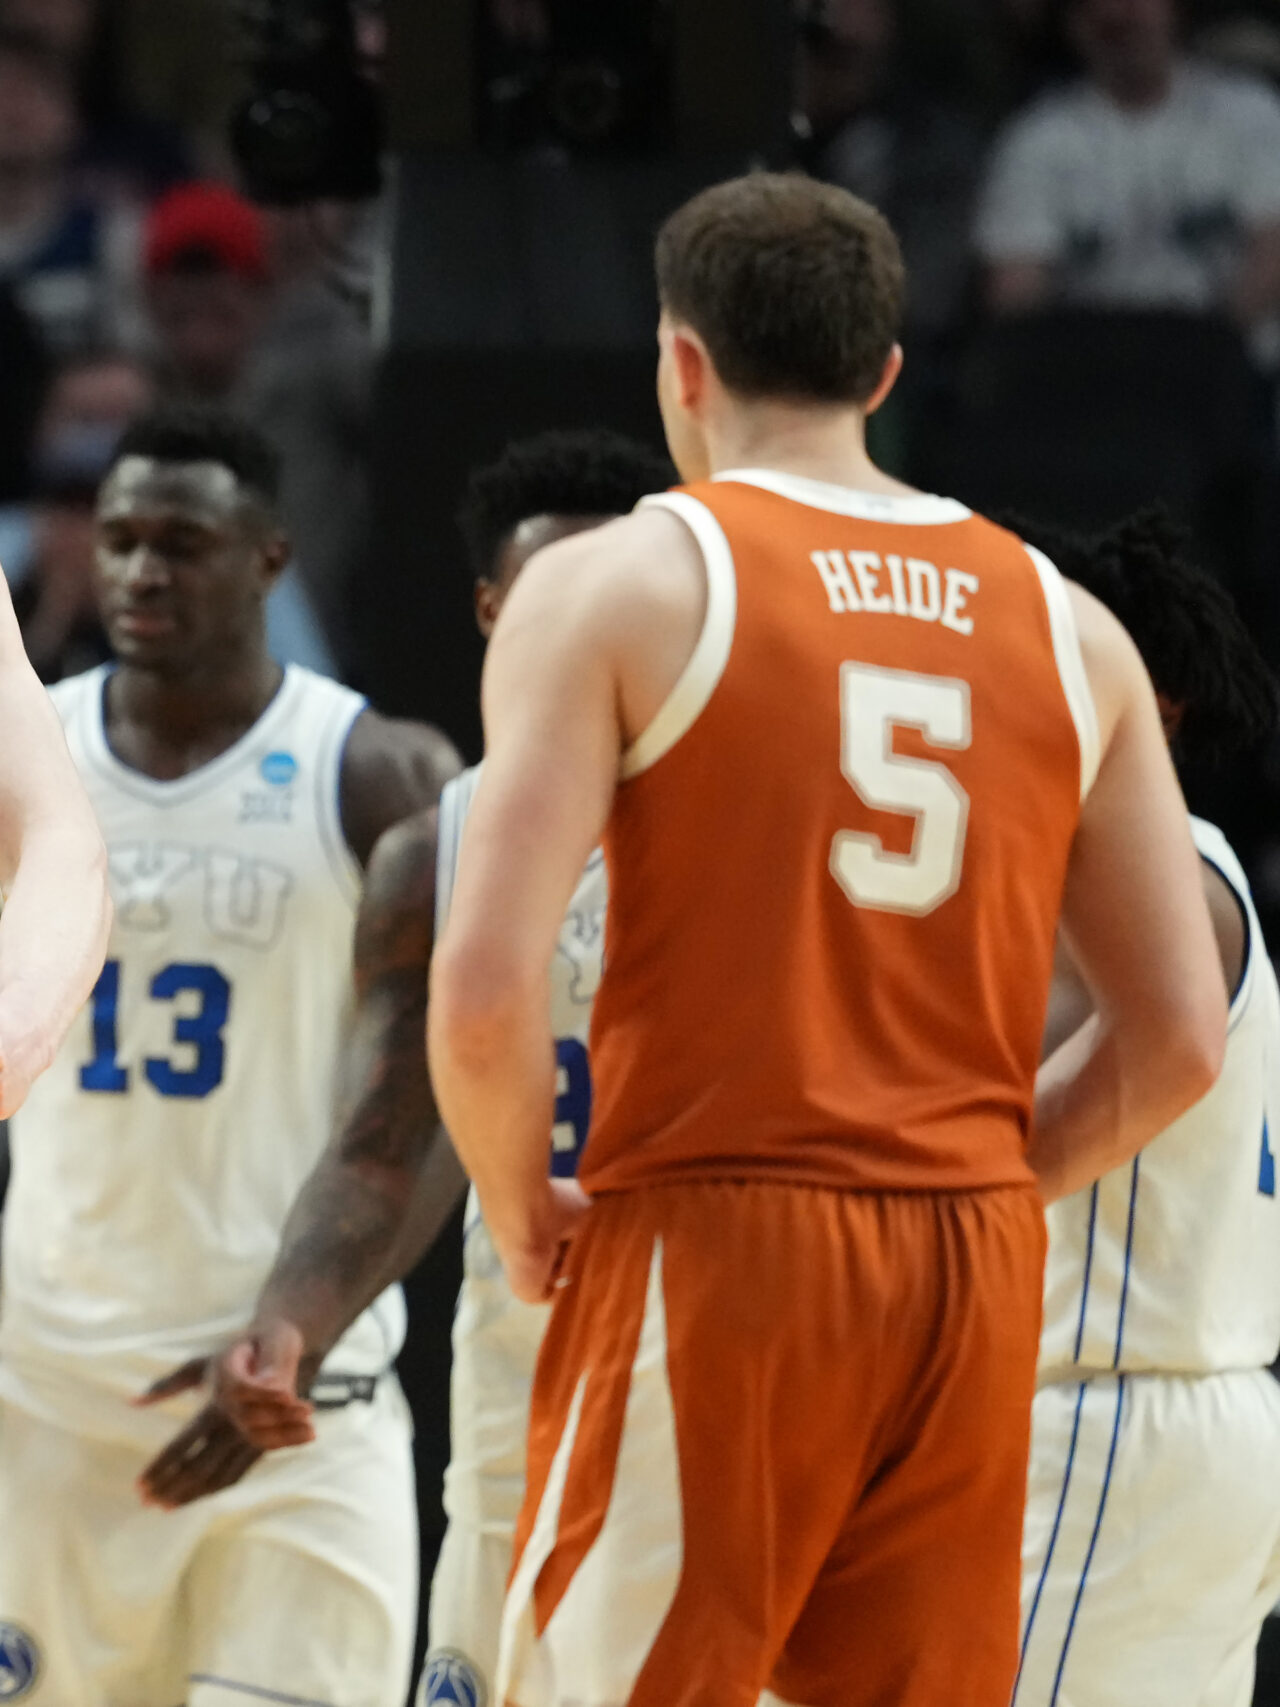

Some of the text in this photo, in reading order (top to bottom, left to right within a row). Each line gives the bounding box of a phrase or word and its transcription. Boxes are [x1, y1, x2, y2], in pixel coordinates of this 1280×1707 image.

[809, 548, 979, 636] HEIDE
[828, 659, 972, 918] 5
[106, 838, 295, 951] YU
[79, 959, 233, 1099] 13
